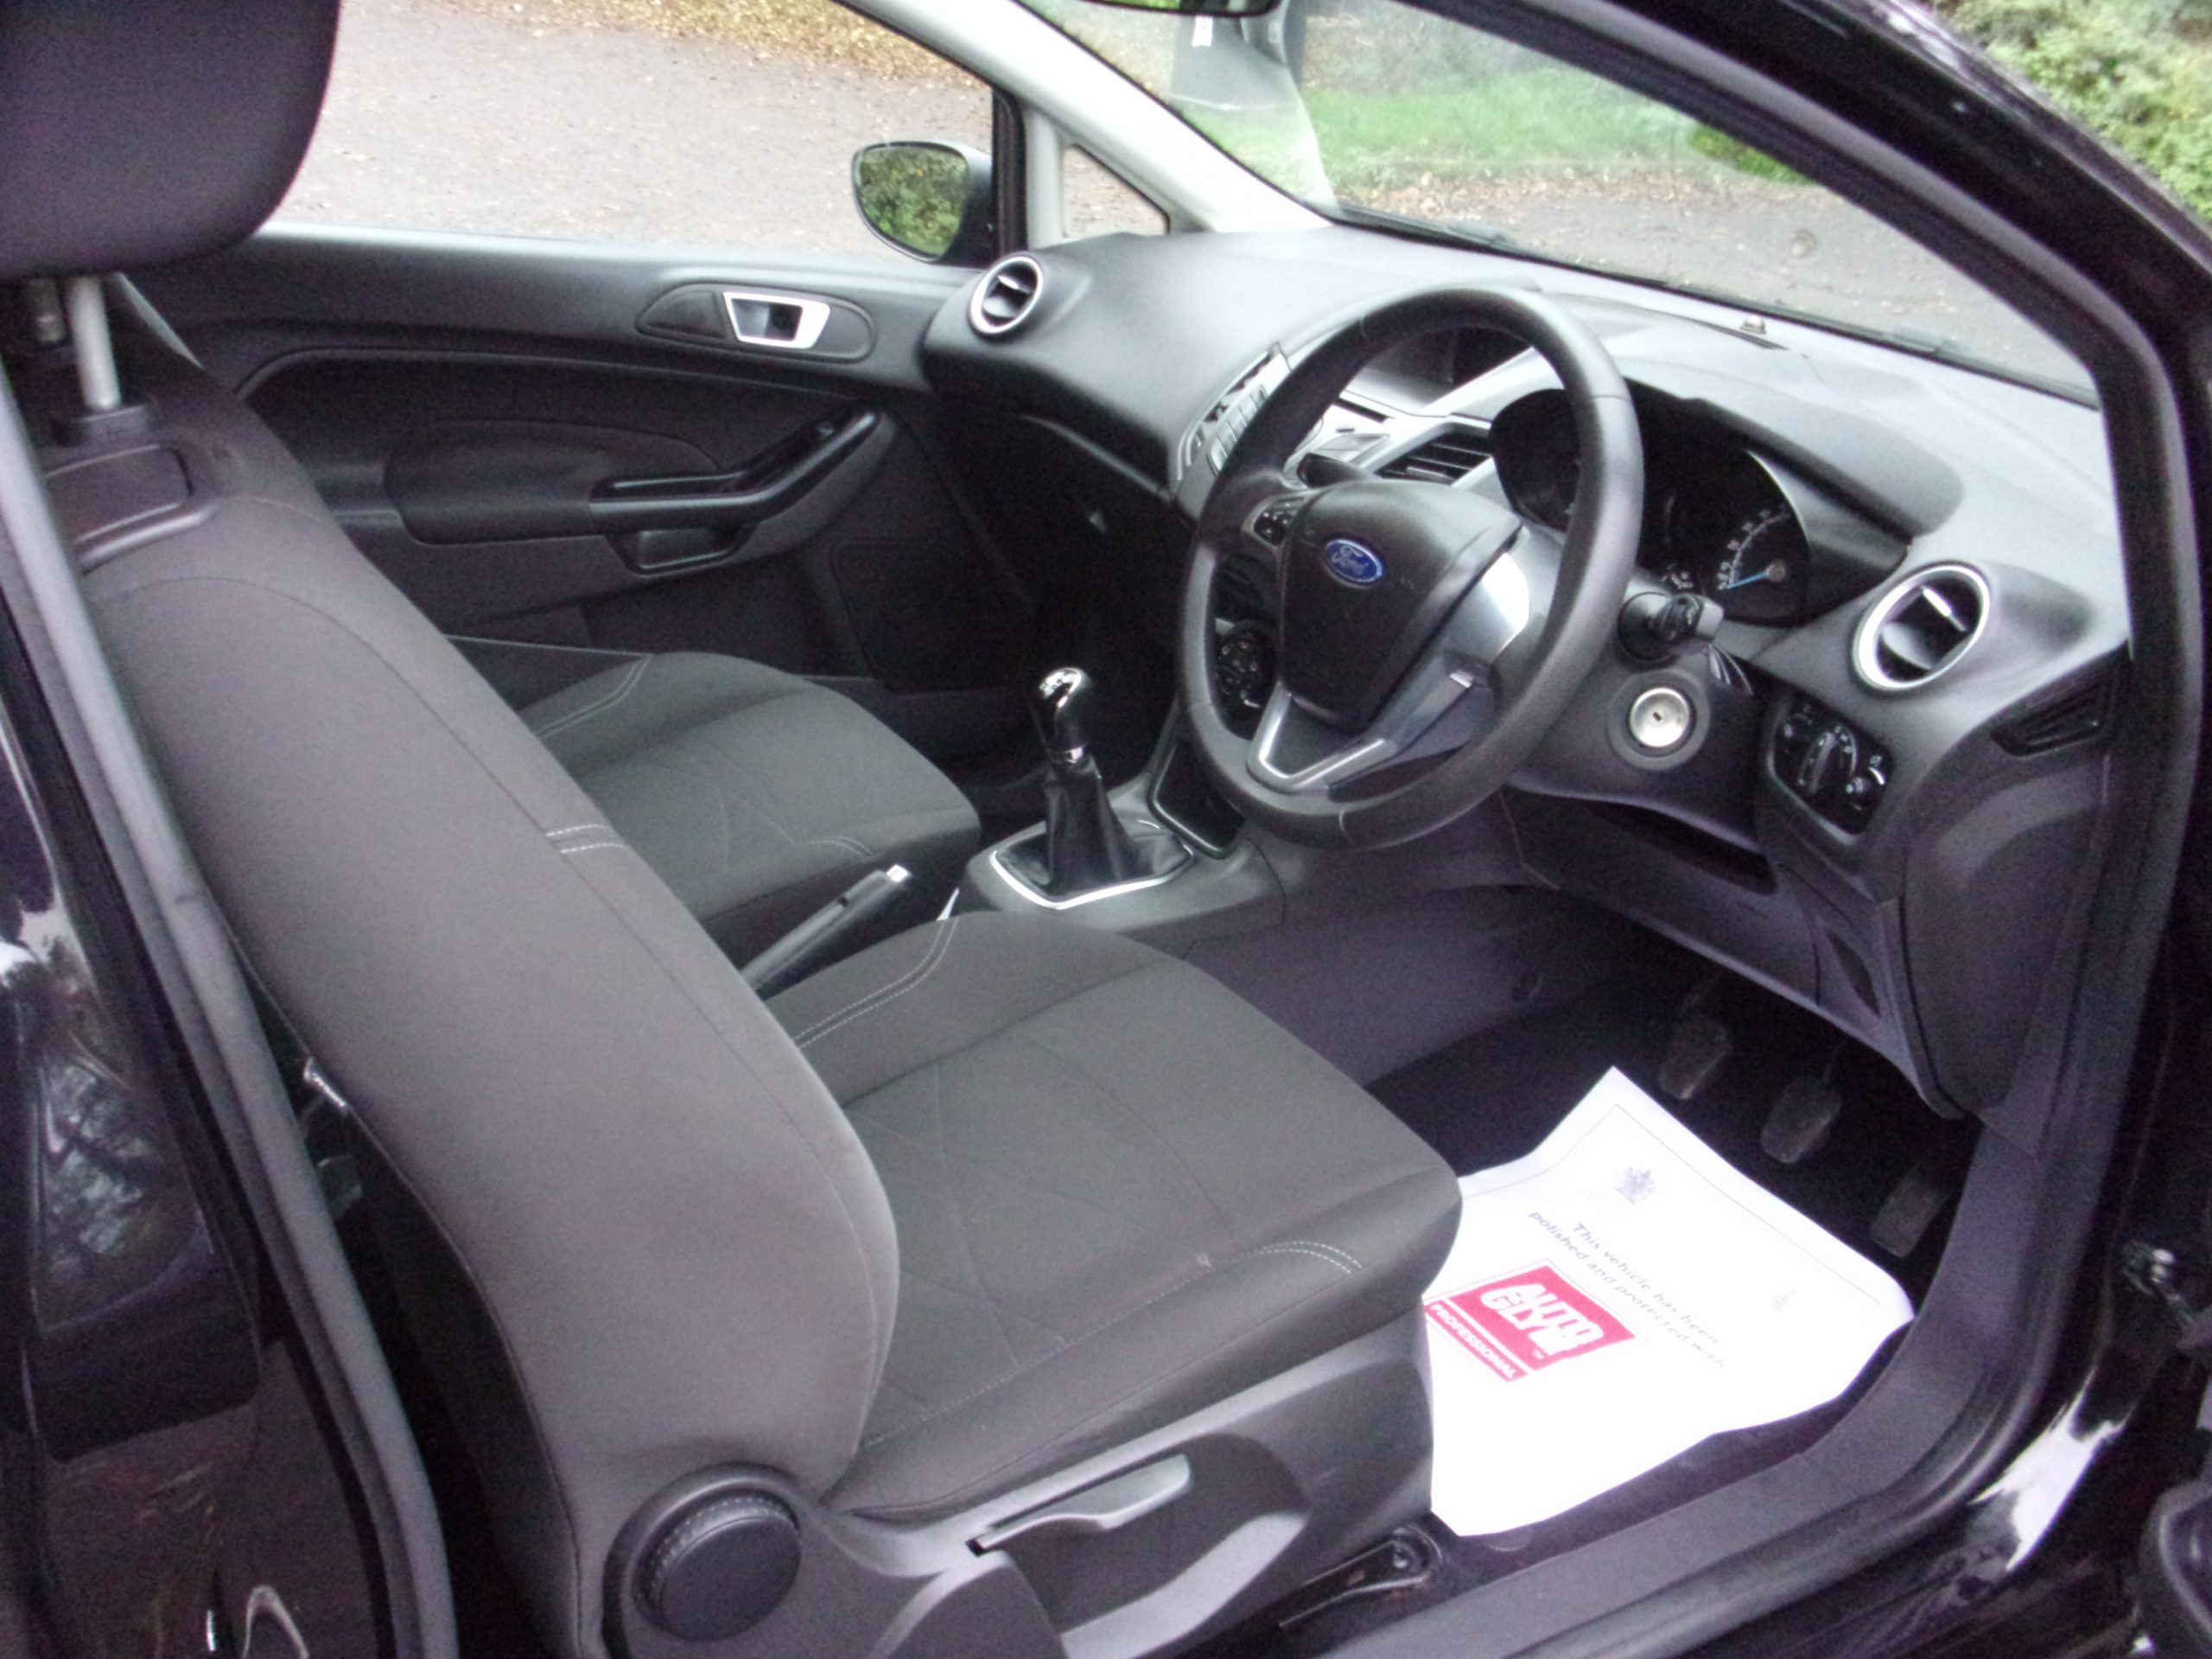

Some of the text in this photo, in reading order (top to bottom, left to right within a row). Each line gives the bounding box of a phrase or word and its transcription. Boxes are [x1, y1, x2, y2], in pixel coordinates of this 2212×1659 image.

[1331, 544, 1370, 576] Ford
[1507, 1282, 1605, 1343] AUTO
[1527, 1211, 1726, 1368] polished and protected with
[1573, 1223, 1719, 1344] This vehicle has been
[1429, 1303, 1516, 1380] PROFESSIONAL
